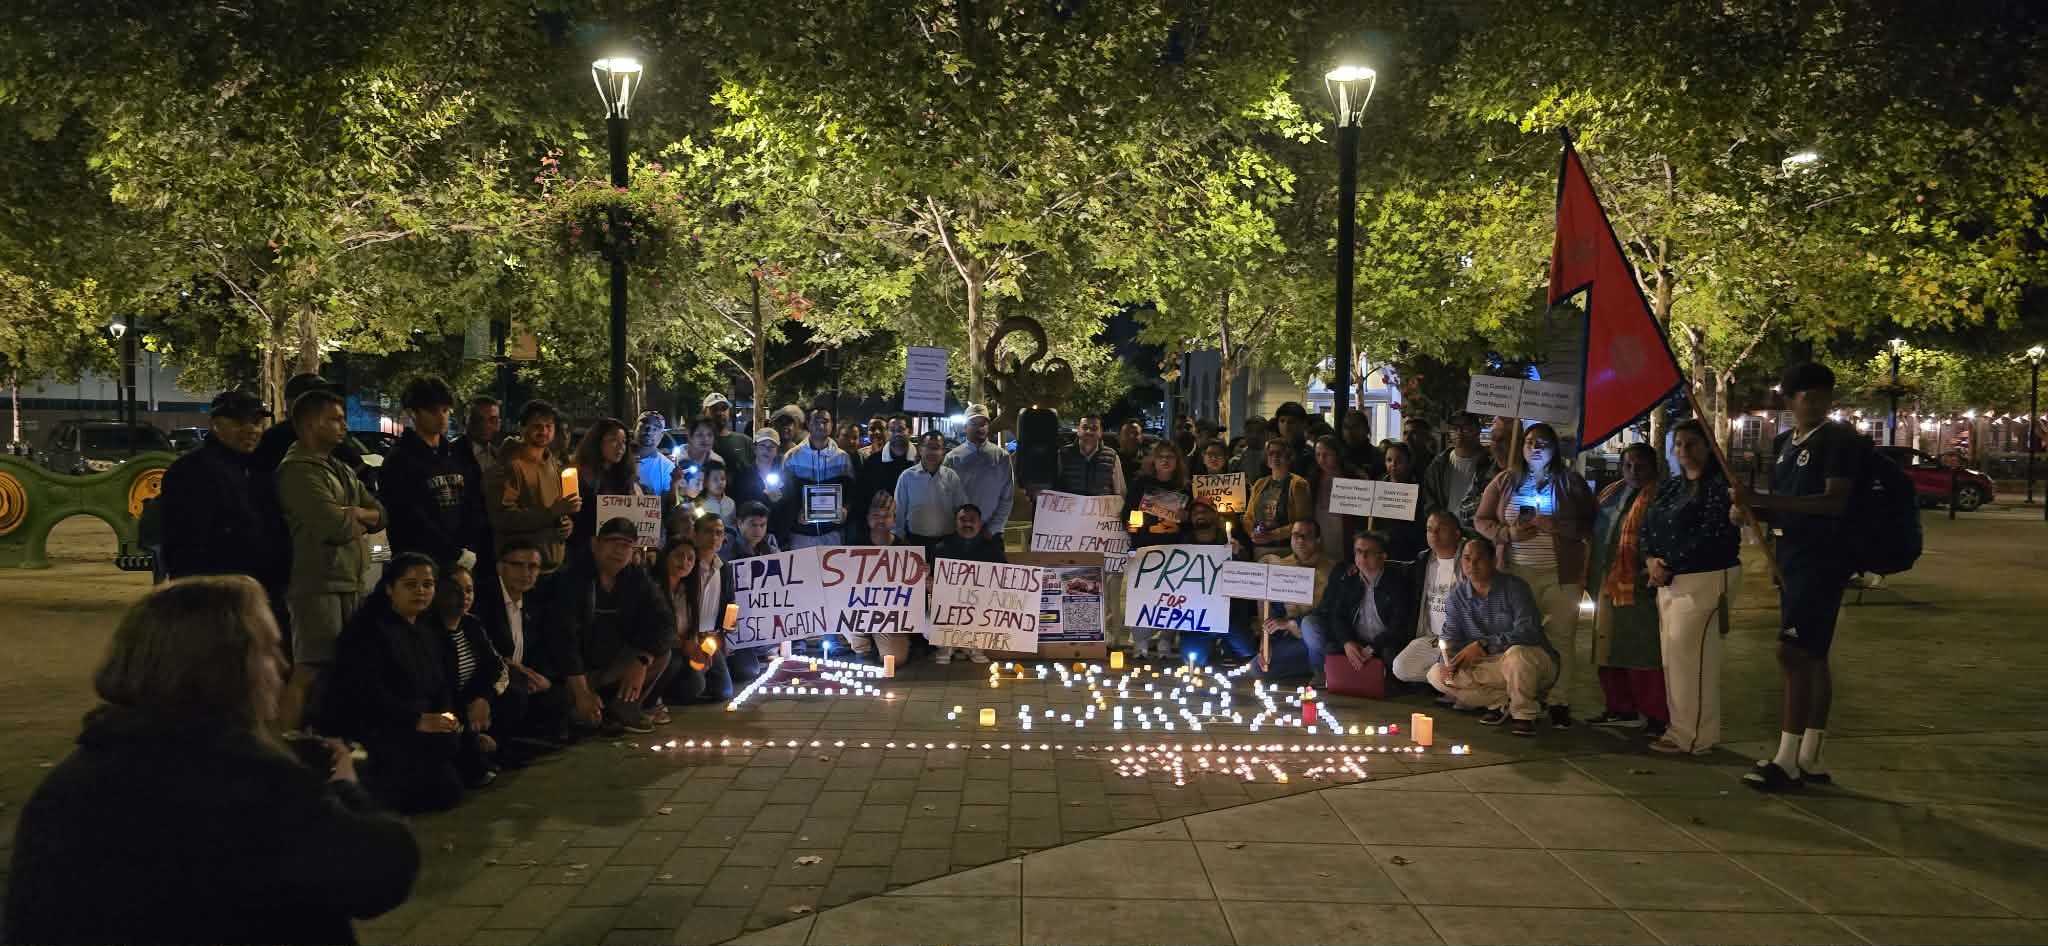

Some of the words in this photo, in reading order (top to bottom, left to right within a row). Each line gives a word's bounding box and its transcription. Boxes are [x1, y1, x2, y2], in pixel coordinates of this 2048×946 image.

[734, 554, 804, 592] EPAL
[822, 548, 929, 587] STAND
[936, 560, 985, 588] NEPAL
[989, 565, 1040, 592] NEEDS
[1134, 548, 1229, 595] PRAY
[748, 589, 795, 608] WILL
[847, 585, 913, 608] WITH
[1156, 592, 1188, 609] FOR
[772, 606, 827, 639] AGAIN
[836, 609, 914, 633] NEPAL
[932, 604, 976, 626] LETS
[1136, 603, 1211, 631] NEPAL
